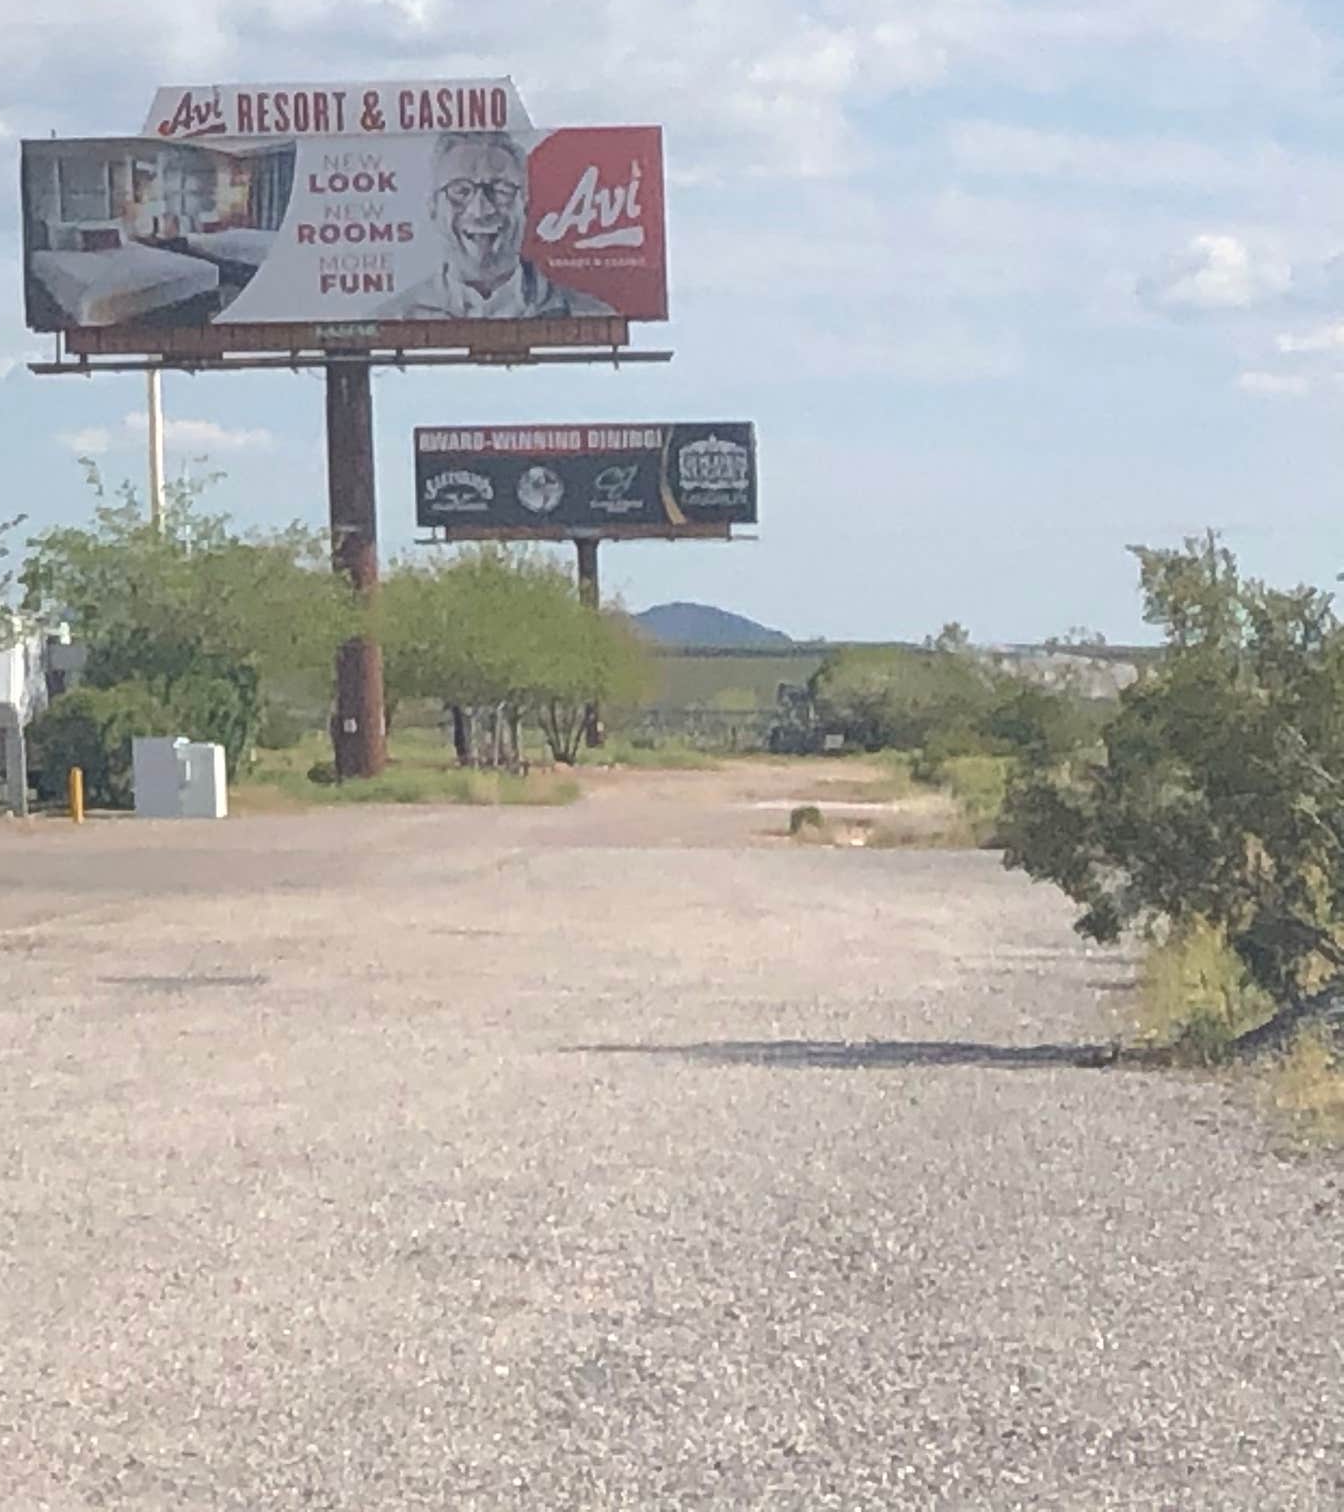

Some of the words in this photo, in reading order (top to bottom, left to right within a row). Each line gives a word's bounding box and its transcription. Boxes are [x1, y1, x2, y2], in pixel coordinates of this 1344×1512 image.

[158, 91, 226, 136] Avi
[237, 91, 346, 133] RESORT
[361, 91, 386, 131] &
[399, 88, 507, 130] CASINO
[323, 153, 383, 171] NEW
[309, 171, 398, 193] LOOK
[324, 201, 384, 221] NEW
[536, 159, 643, 248] Avi
[298, 221, 414, 244] ROOMS
[319, 252, 394, 272] MORE
[321, 273, 395, 294] FUN!
